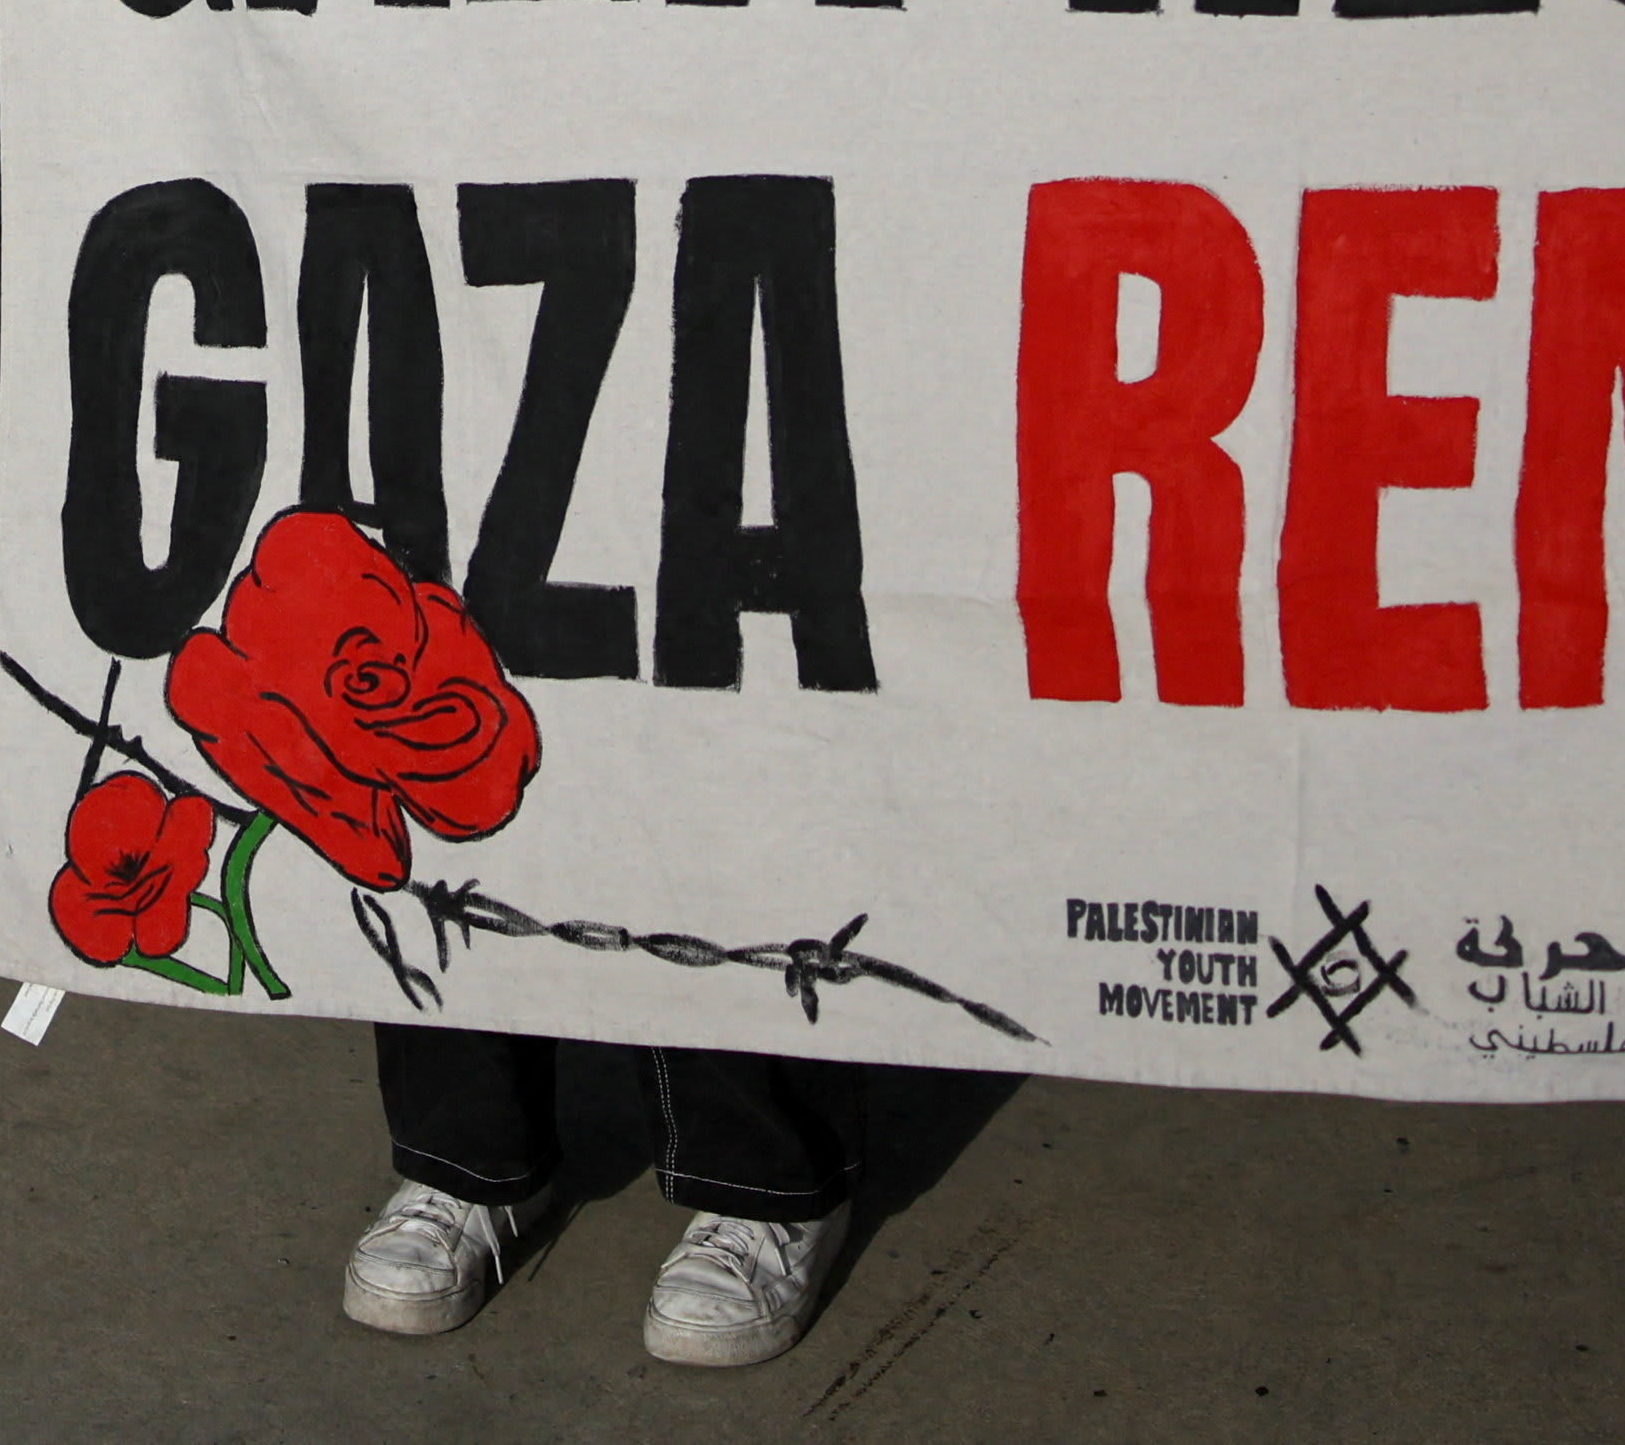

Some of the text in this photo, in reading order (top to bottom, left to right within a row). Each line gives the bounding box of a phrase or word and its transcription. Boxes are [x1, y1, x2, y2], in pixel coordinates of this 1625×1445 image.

[61, 173, 878, 694] GAZA
[1066, 898, 1258, 945] PALESTINIAN
[1156, 948, 1257, 988] YOUTH
[1099, 982, 1258, 1026] MOVEMENT
[1467, 971, 1605, 1020] الشباب
